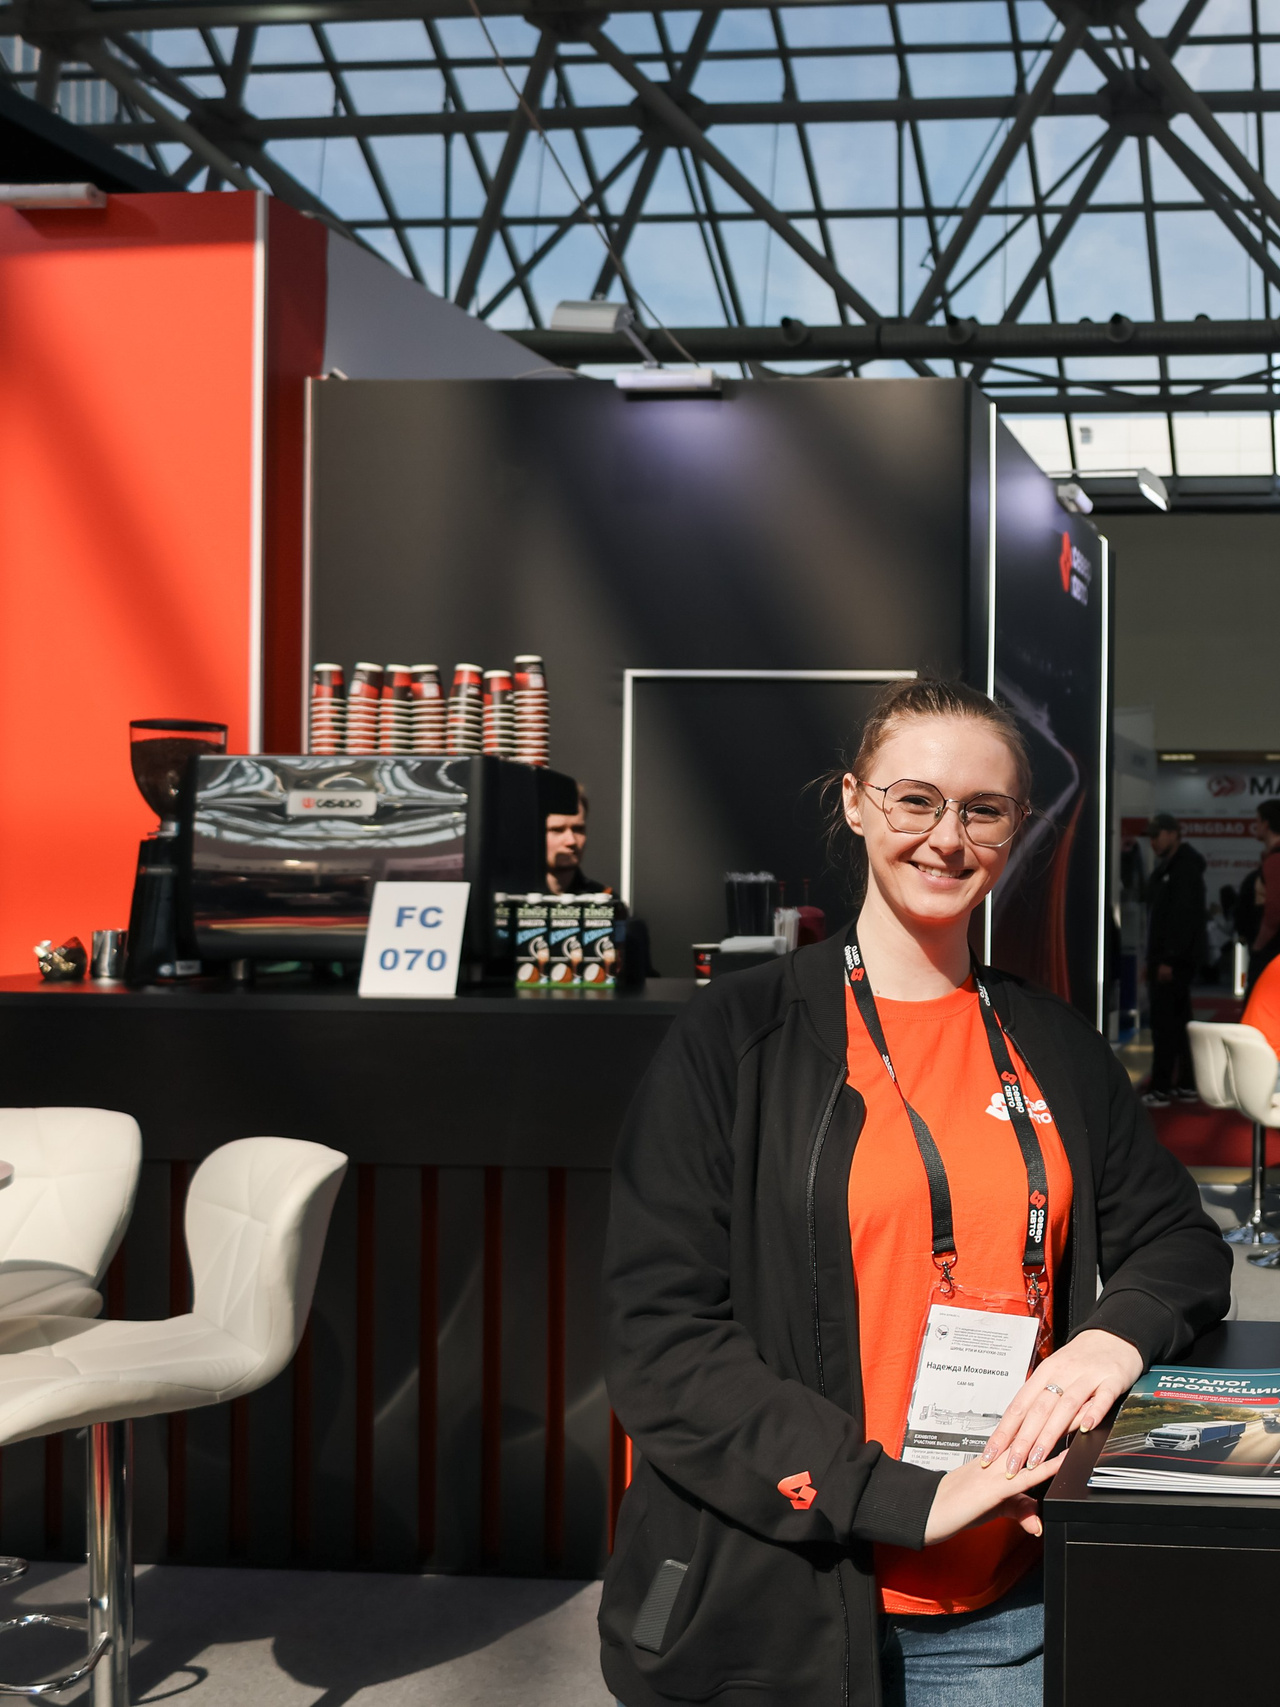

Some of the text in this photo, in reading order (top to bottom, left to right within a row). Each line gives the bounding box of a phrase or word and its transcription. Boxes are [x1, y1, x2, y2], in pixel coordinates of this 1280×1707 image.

[395, 906, 444, 929] FC
[379, 949, 448, 972] 070
[851, 945, 861, 966] авто
[1004, 1085, 1016, 1109] авто
[1011, 1085, 1025, 1114] север
[1029, 1209, 1038, 1237] авто
[1034, 1209, 1045, 1243] север
[926, 1362, 1009, 1377] Надежда Моховикова
[1159, 1375, 1250, 1387] КАТАЛОГ
